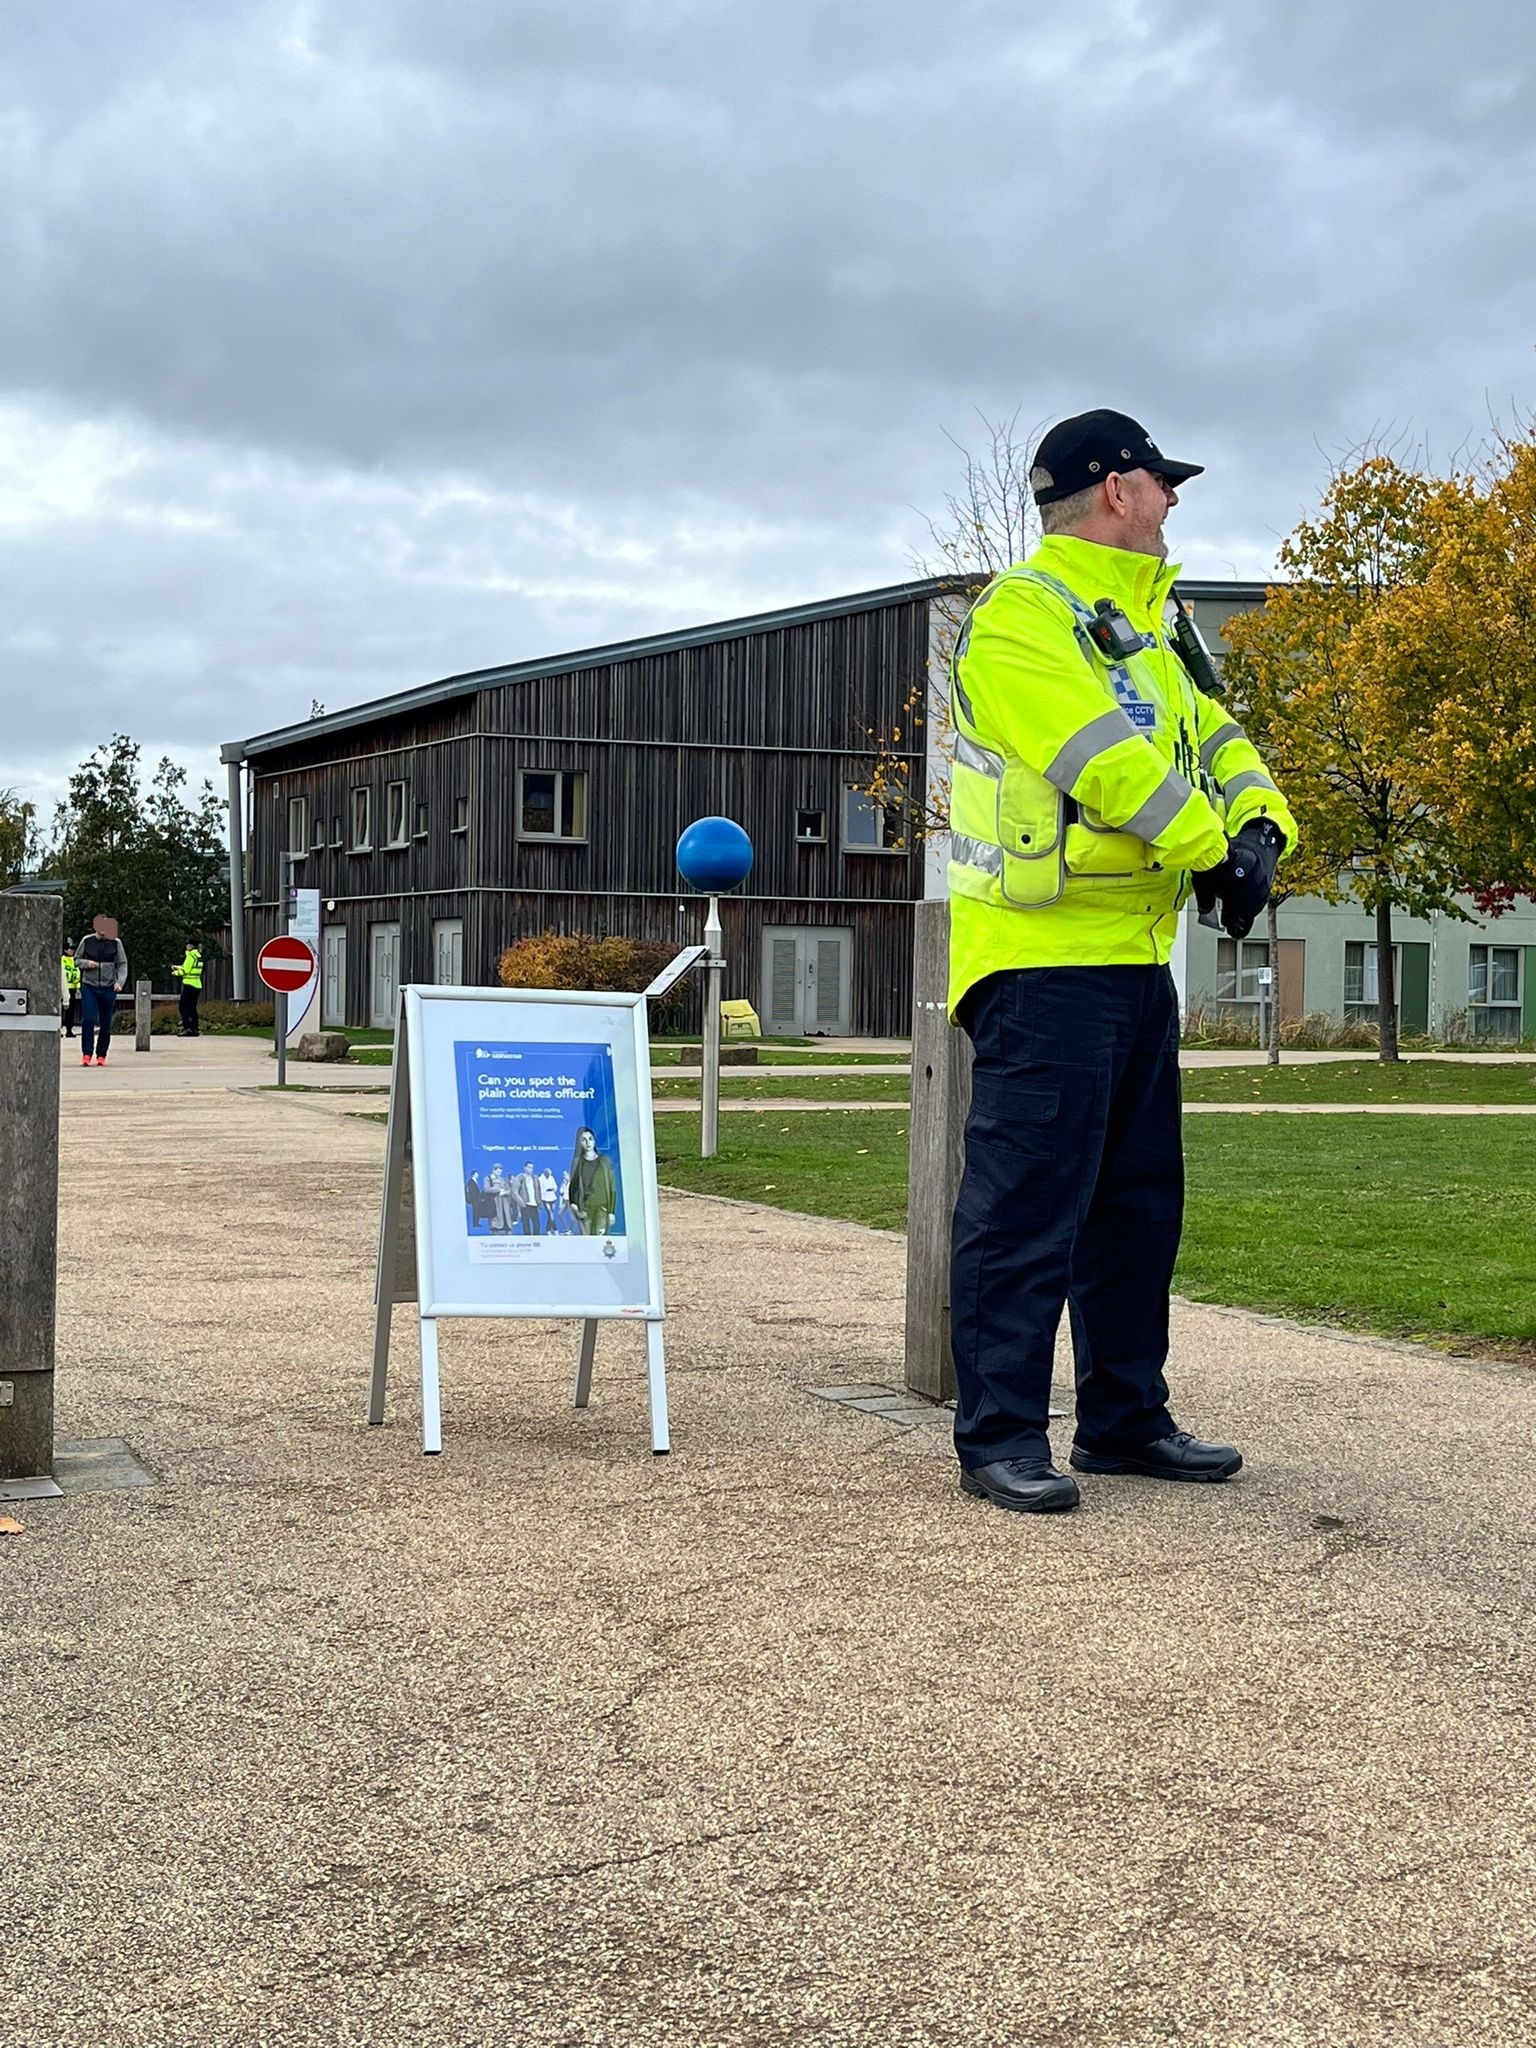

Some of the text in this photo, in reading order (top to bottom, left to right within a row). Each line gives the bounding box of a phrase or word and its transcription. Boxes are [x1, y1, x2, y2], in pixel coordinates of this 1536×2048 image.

[1134, 706, 1154, 714] CCTV
[478, 1074, 576, 1088] Can you spot the
[479, 1087, 595, 1100] plain clothes officer?
